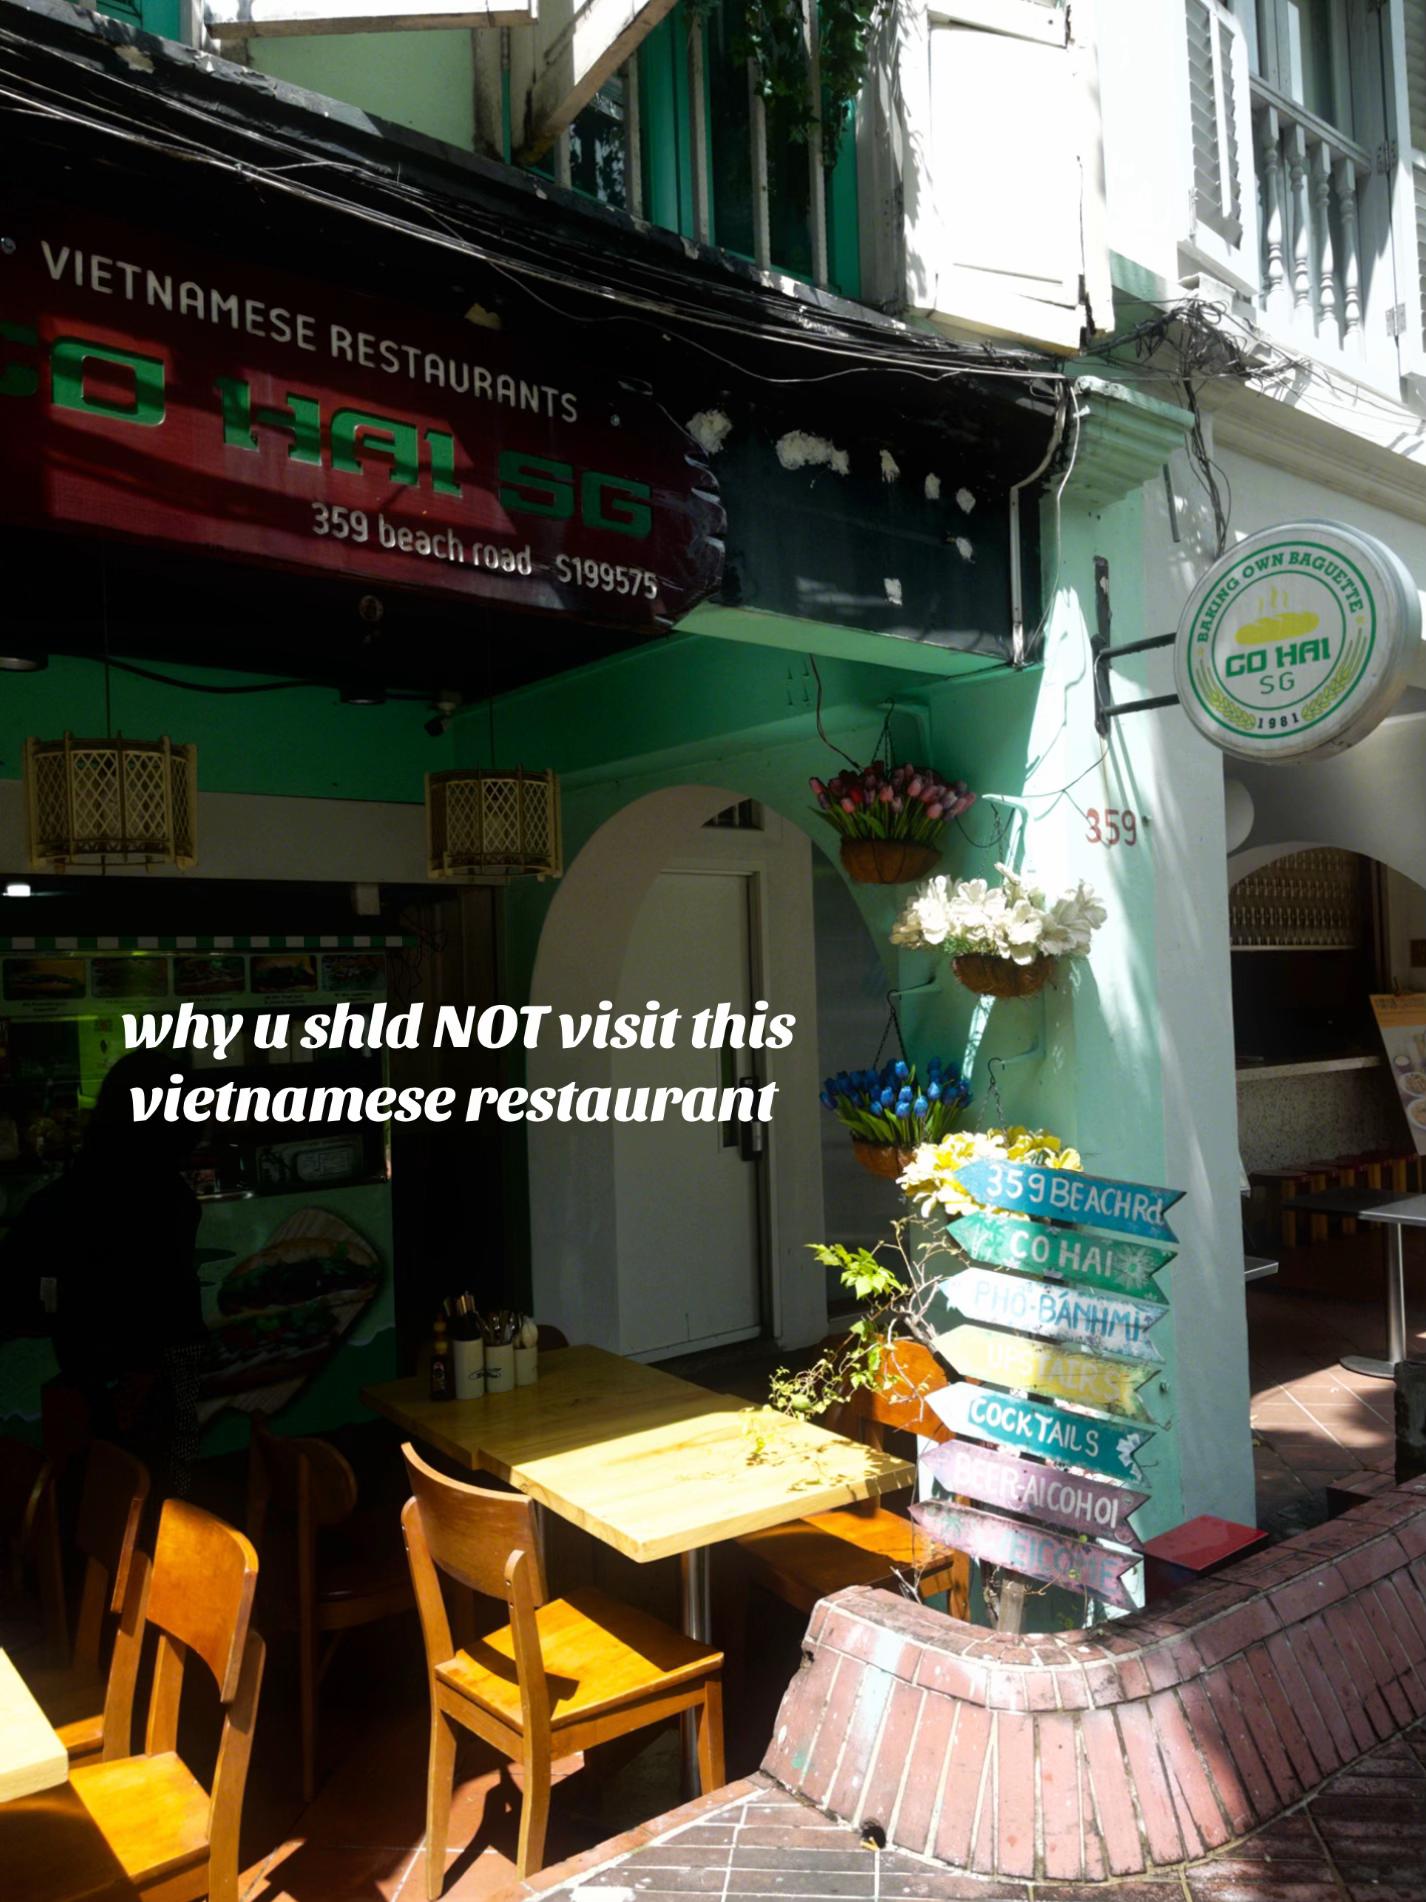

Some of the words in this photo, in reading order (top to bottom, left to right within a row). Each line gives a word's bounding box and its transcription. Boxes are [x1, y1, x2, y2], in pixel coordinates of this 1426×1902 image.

[41, 240, 317, 351] VIETNAMESE
[330, 322, 578, 424] RESTAURANTS
[214, 374, 462, 499] HAI
[499, 449, 653, 539] SG
[311, 501, 369, 543] 359
[378, 513, 464, 563] beach
[472, 543, 532, 576] road
[555, 553, 658, 600] S199575
[1196, 577, 1241, 643] BAKING
[1242, 552, 1285, 579] OWN
[1288, 551, 1364, 614] BAGUETTE
[1275, 637, 1331, 668] HAI
[1259, 671, 1296, 695] SG
[1257, 712, 1300, 729] 1981
[1086, 808, 1138, 847] 359
[985, 1163, 1046, 1203] 359
[1010, 1230, 1050, 1263] CO
[1058, 1240, 1113, 1278] HAI
[988, 1343, 1122, 1400] UPSTAIRS
[971, 1398, 1099, 1457] COCKTAILS
